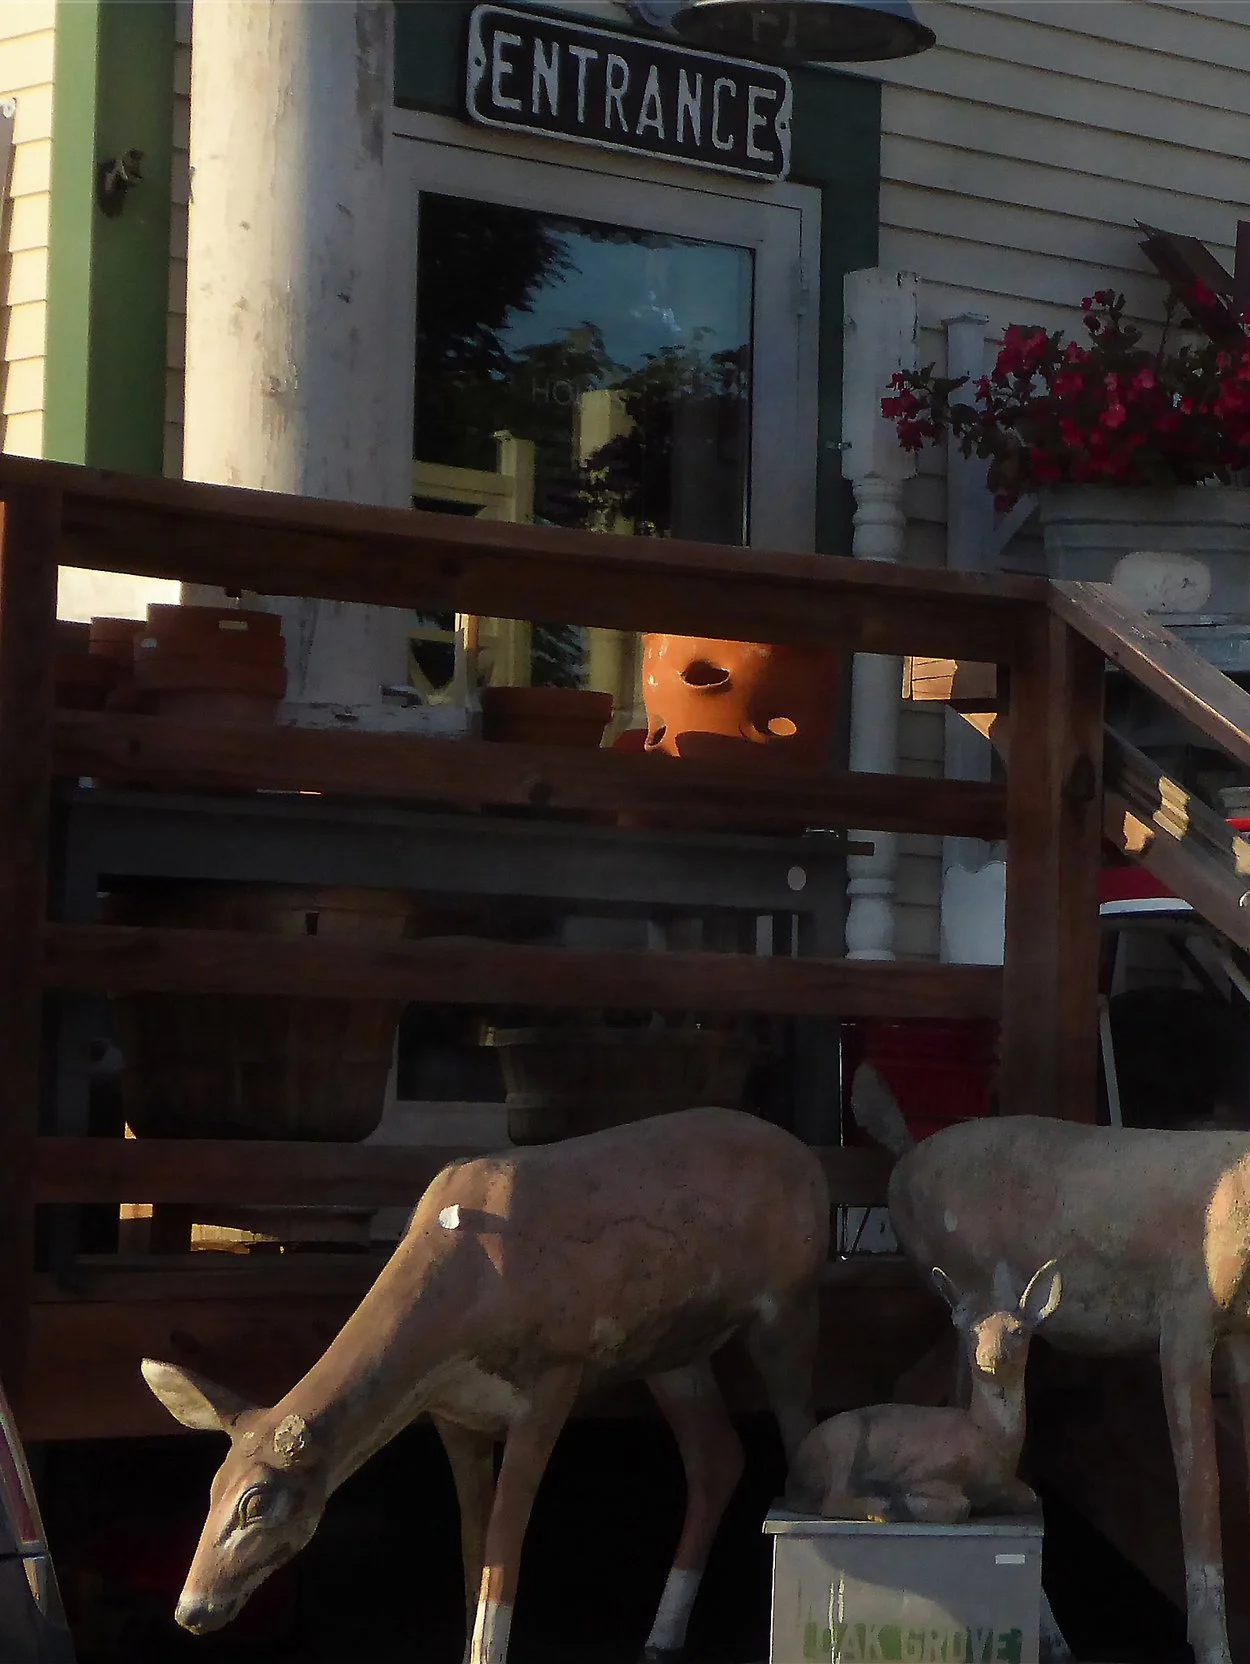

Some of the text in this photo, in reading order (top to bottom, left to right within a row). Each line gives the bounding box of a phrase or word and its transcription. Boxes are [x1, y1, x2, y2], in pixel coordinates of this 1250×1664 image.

[491, 29, 777, 162] ENTRANCE
[812, 1621, 1016, 1664] OAK GROVE
